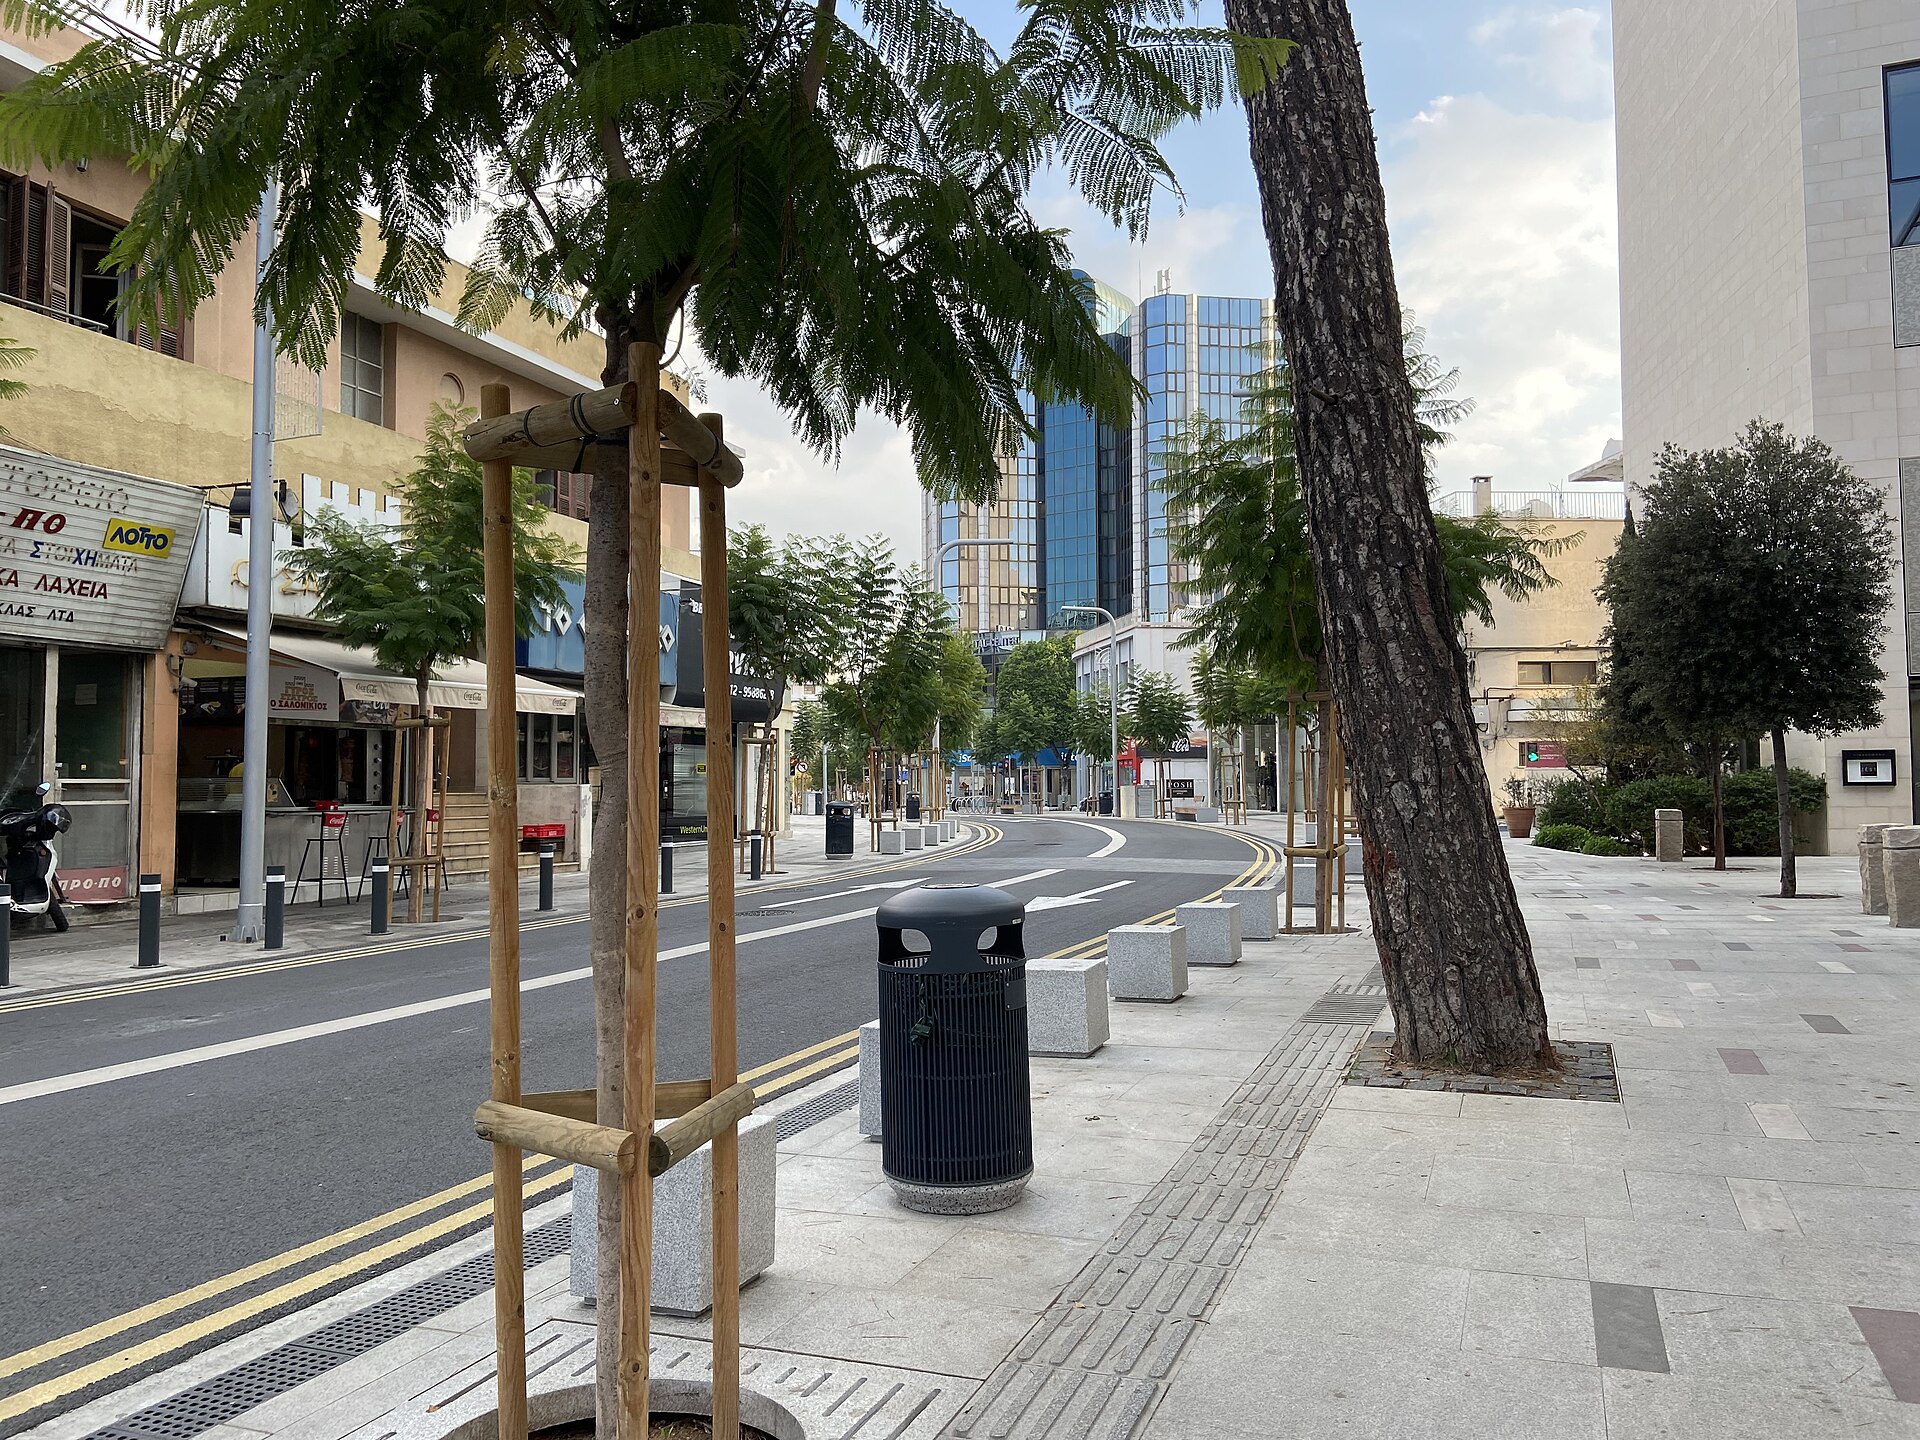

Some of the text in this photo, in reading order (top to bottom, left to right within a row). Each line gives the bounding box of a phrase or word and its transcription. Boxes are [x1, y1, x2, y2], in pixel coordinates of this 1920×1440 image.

[110, 526, 169, 550] ΛΟΤΤΟ
[33, 574, 108, 599] ΛΑΧΕΙΑ
[46, 609, 74, 622] ΛΤΔ
[279, 700, 328, 710] ΣΑΛΟΝΙΚΙΟΣ
[59, 876, 121, 890] ΠΡΟ-ΠΟ
